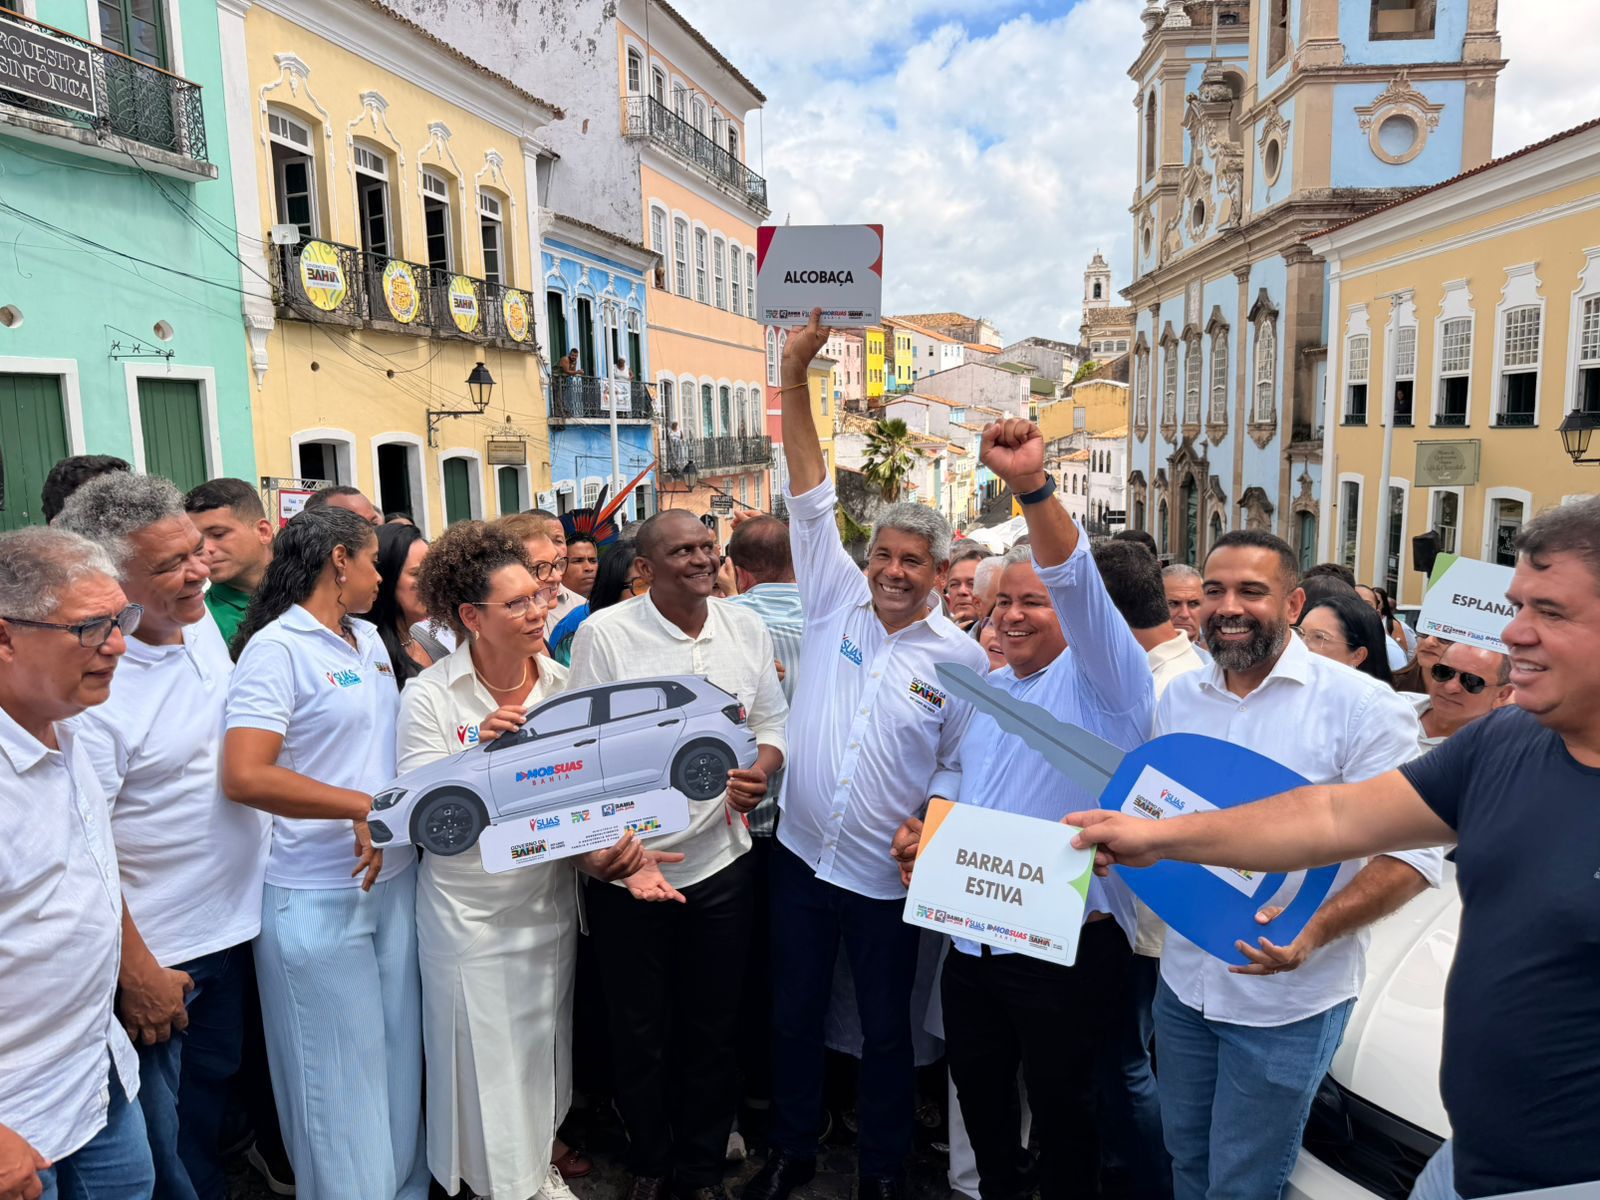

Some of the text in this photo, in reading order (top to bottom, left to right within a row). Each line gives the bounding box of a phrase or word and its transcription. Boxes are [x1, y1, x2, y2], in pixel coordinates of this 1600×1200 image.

[0, 55, 92, 102] SINFÔNICA
[306, 268, 340, 284] BAHIA
[784, 270, 854, 287] ALCOBAÇA
[453, 298, 475, 311] BAHIA
[840, 639, 863, 663] SUAS
[333, 669, 359, 681] SUAS
[912, 677, 940, 695] GOVERNO
[909, 681, 944, 709] BAHIA
[527, 760, 583, 780] MOBSUAS
[615, 801, 635, 809] BAHIA
[1133, 797, 1160, 819] BAHIA
[1166, 793, 1186, 809] SUAS
[536, 815, 560, 828] SUAS
[571, 812, 590, 823] PAZ
[510, 840, 537, 851] GOVERNO
[511, 844, 547, 860] BAHIA
[956, 848, 1045, 885] BARRA DA
[965, 876, 1023, 906] ESTIVA
